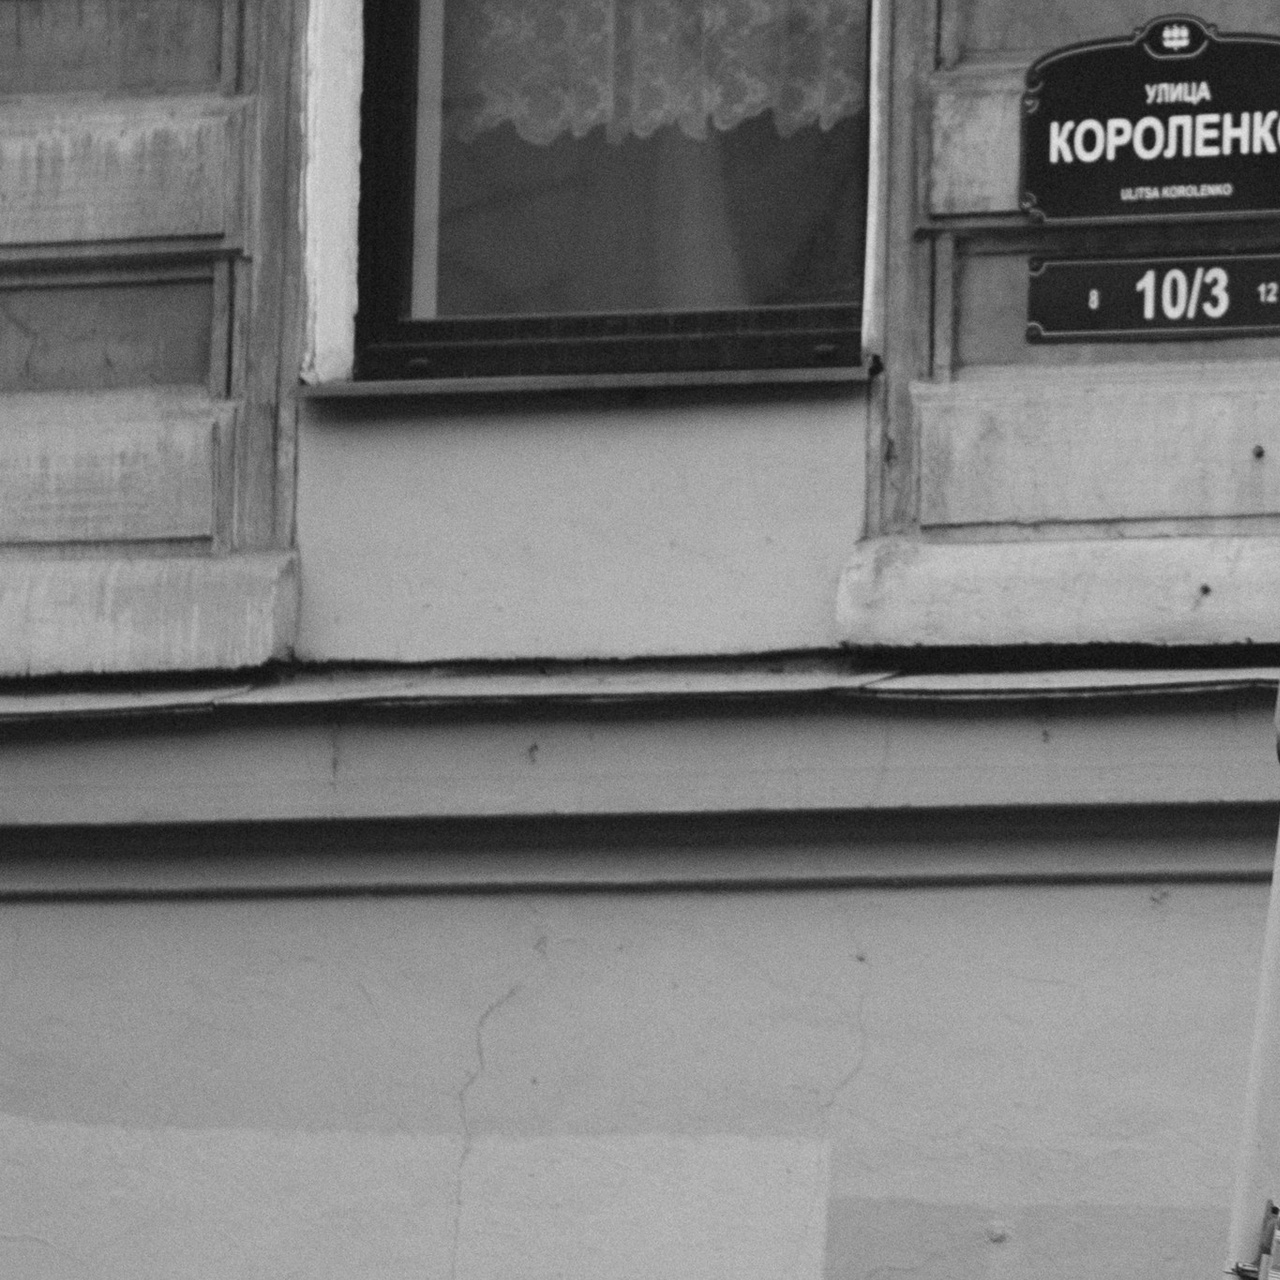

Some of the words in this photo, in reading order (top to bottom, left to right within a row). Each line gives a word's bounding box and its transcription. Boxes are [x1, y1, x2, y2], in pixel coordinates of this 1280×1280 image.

[1144, 81, 1212, 104] УЛИЦА
[1120, 186, 1160, 201] ULITSA
[1161, 183, 1233, 199] KOROLENKO
[1088, 288, 1099, 310] 8
[1135, 267, 1230, 320] 10/3
[1257, 282, 1279, 304] 12
